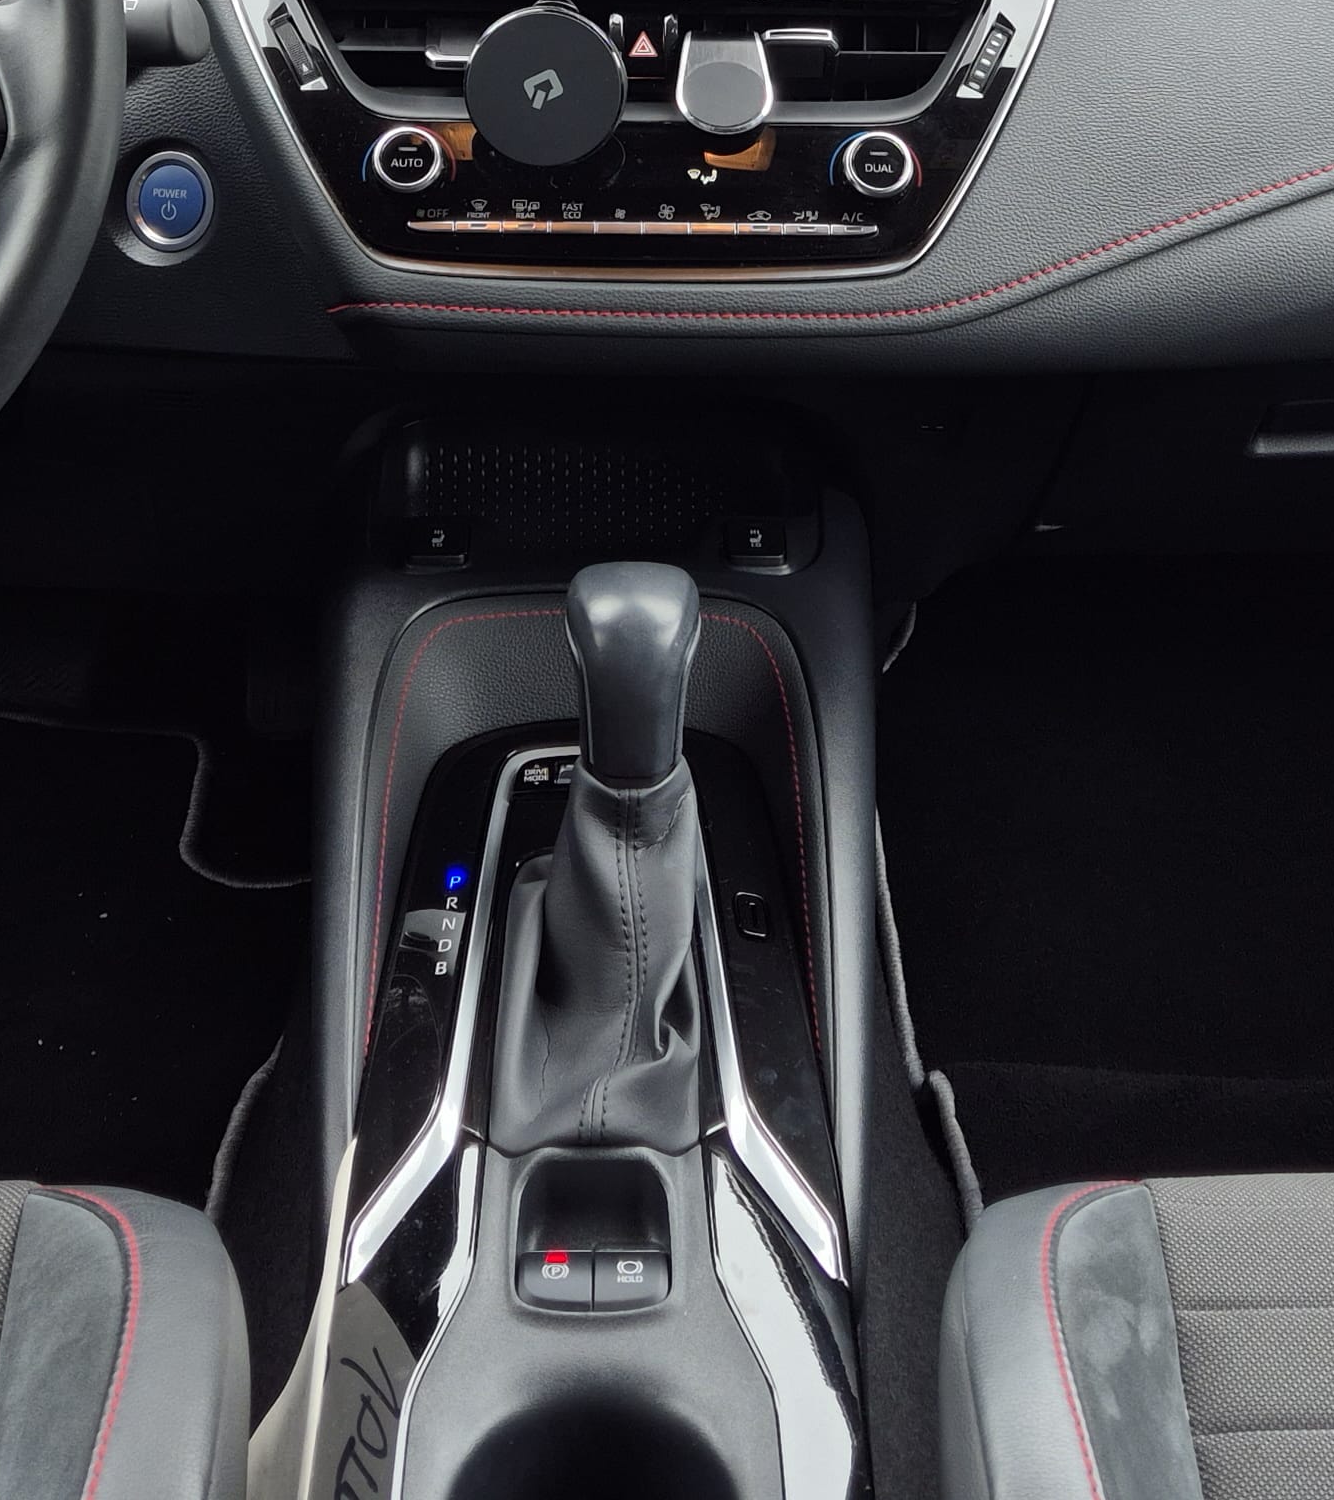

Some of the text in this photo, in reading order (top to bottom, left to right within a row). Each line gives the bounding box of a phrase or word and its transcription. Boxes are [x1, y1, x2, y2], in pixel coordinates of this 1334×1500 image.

[390, 158, 423, 168] AUTO
[864, 161, 895, 175] DUAL
[152, 188, 187, 199] POWER
[561, 203, 584, 211] FAST
[426, 208, 451, 219] OFF
[467, 211, 491, 219] FRONT
[563, 211, 582, 219] ECO
[841, 212, 864, 222] A/C
[449, 876, 461, 889] P
[445, 896, 458, 910] R
[441, 917, 457, 932] N
[437, 939, 452, 953] D
[434, 962, 447, 975] B
[616, 1275, 644, 1284] HOLD
